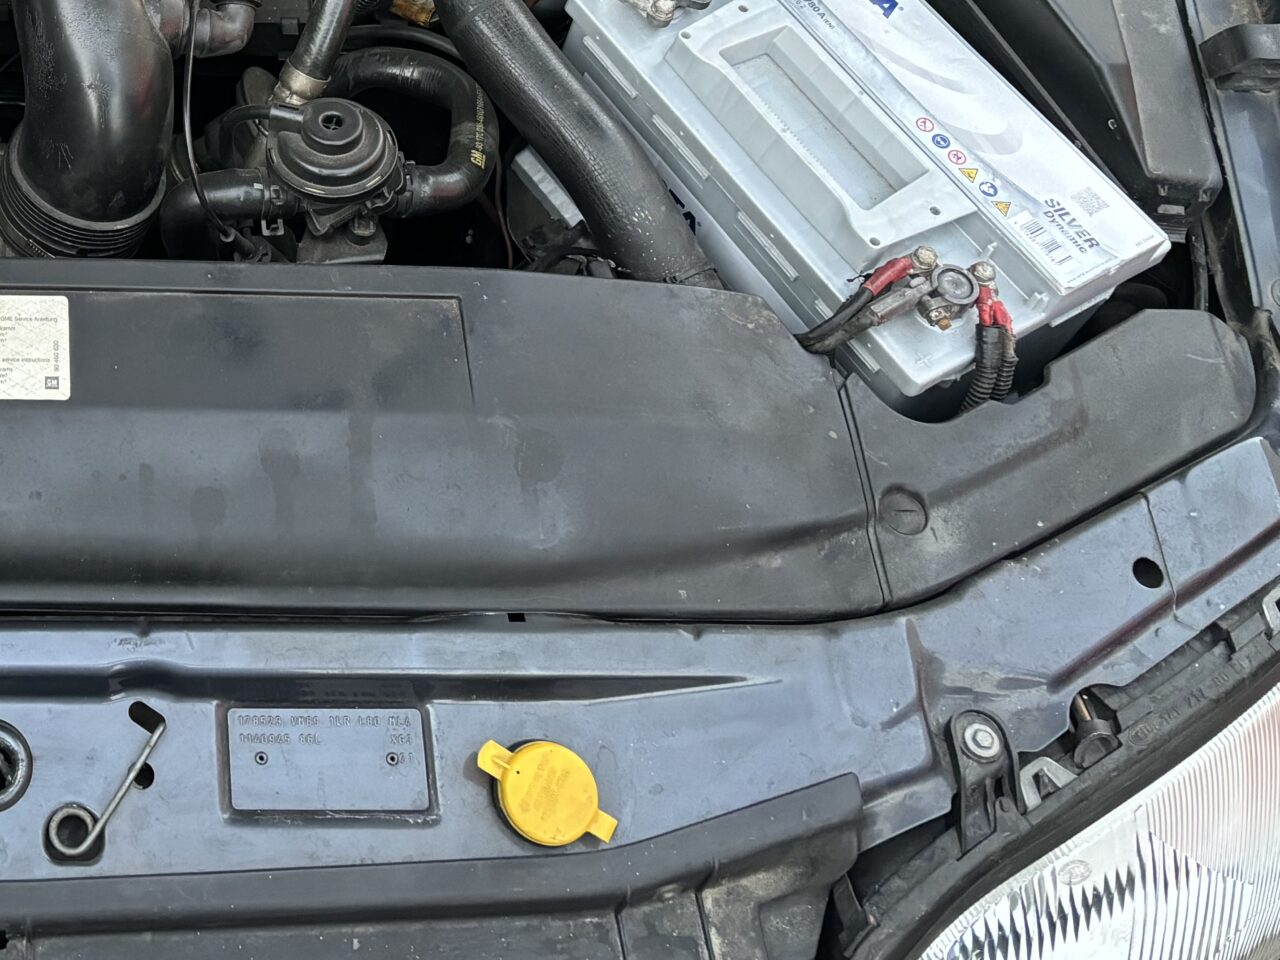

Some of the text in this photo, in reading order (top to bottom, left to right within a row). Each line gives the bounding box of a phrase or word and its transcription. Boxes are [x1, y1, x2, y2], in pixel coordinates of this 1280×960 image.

[469, 148, 483, 166] GM
[1043, 210, 1087, 254] Dynamic
[1044, 198, 1100, 249] SILVER
